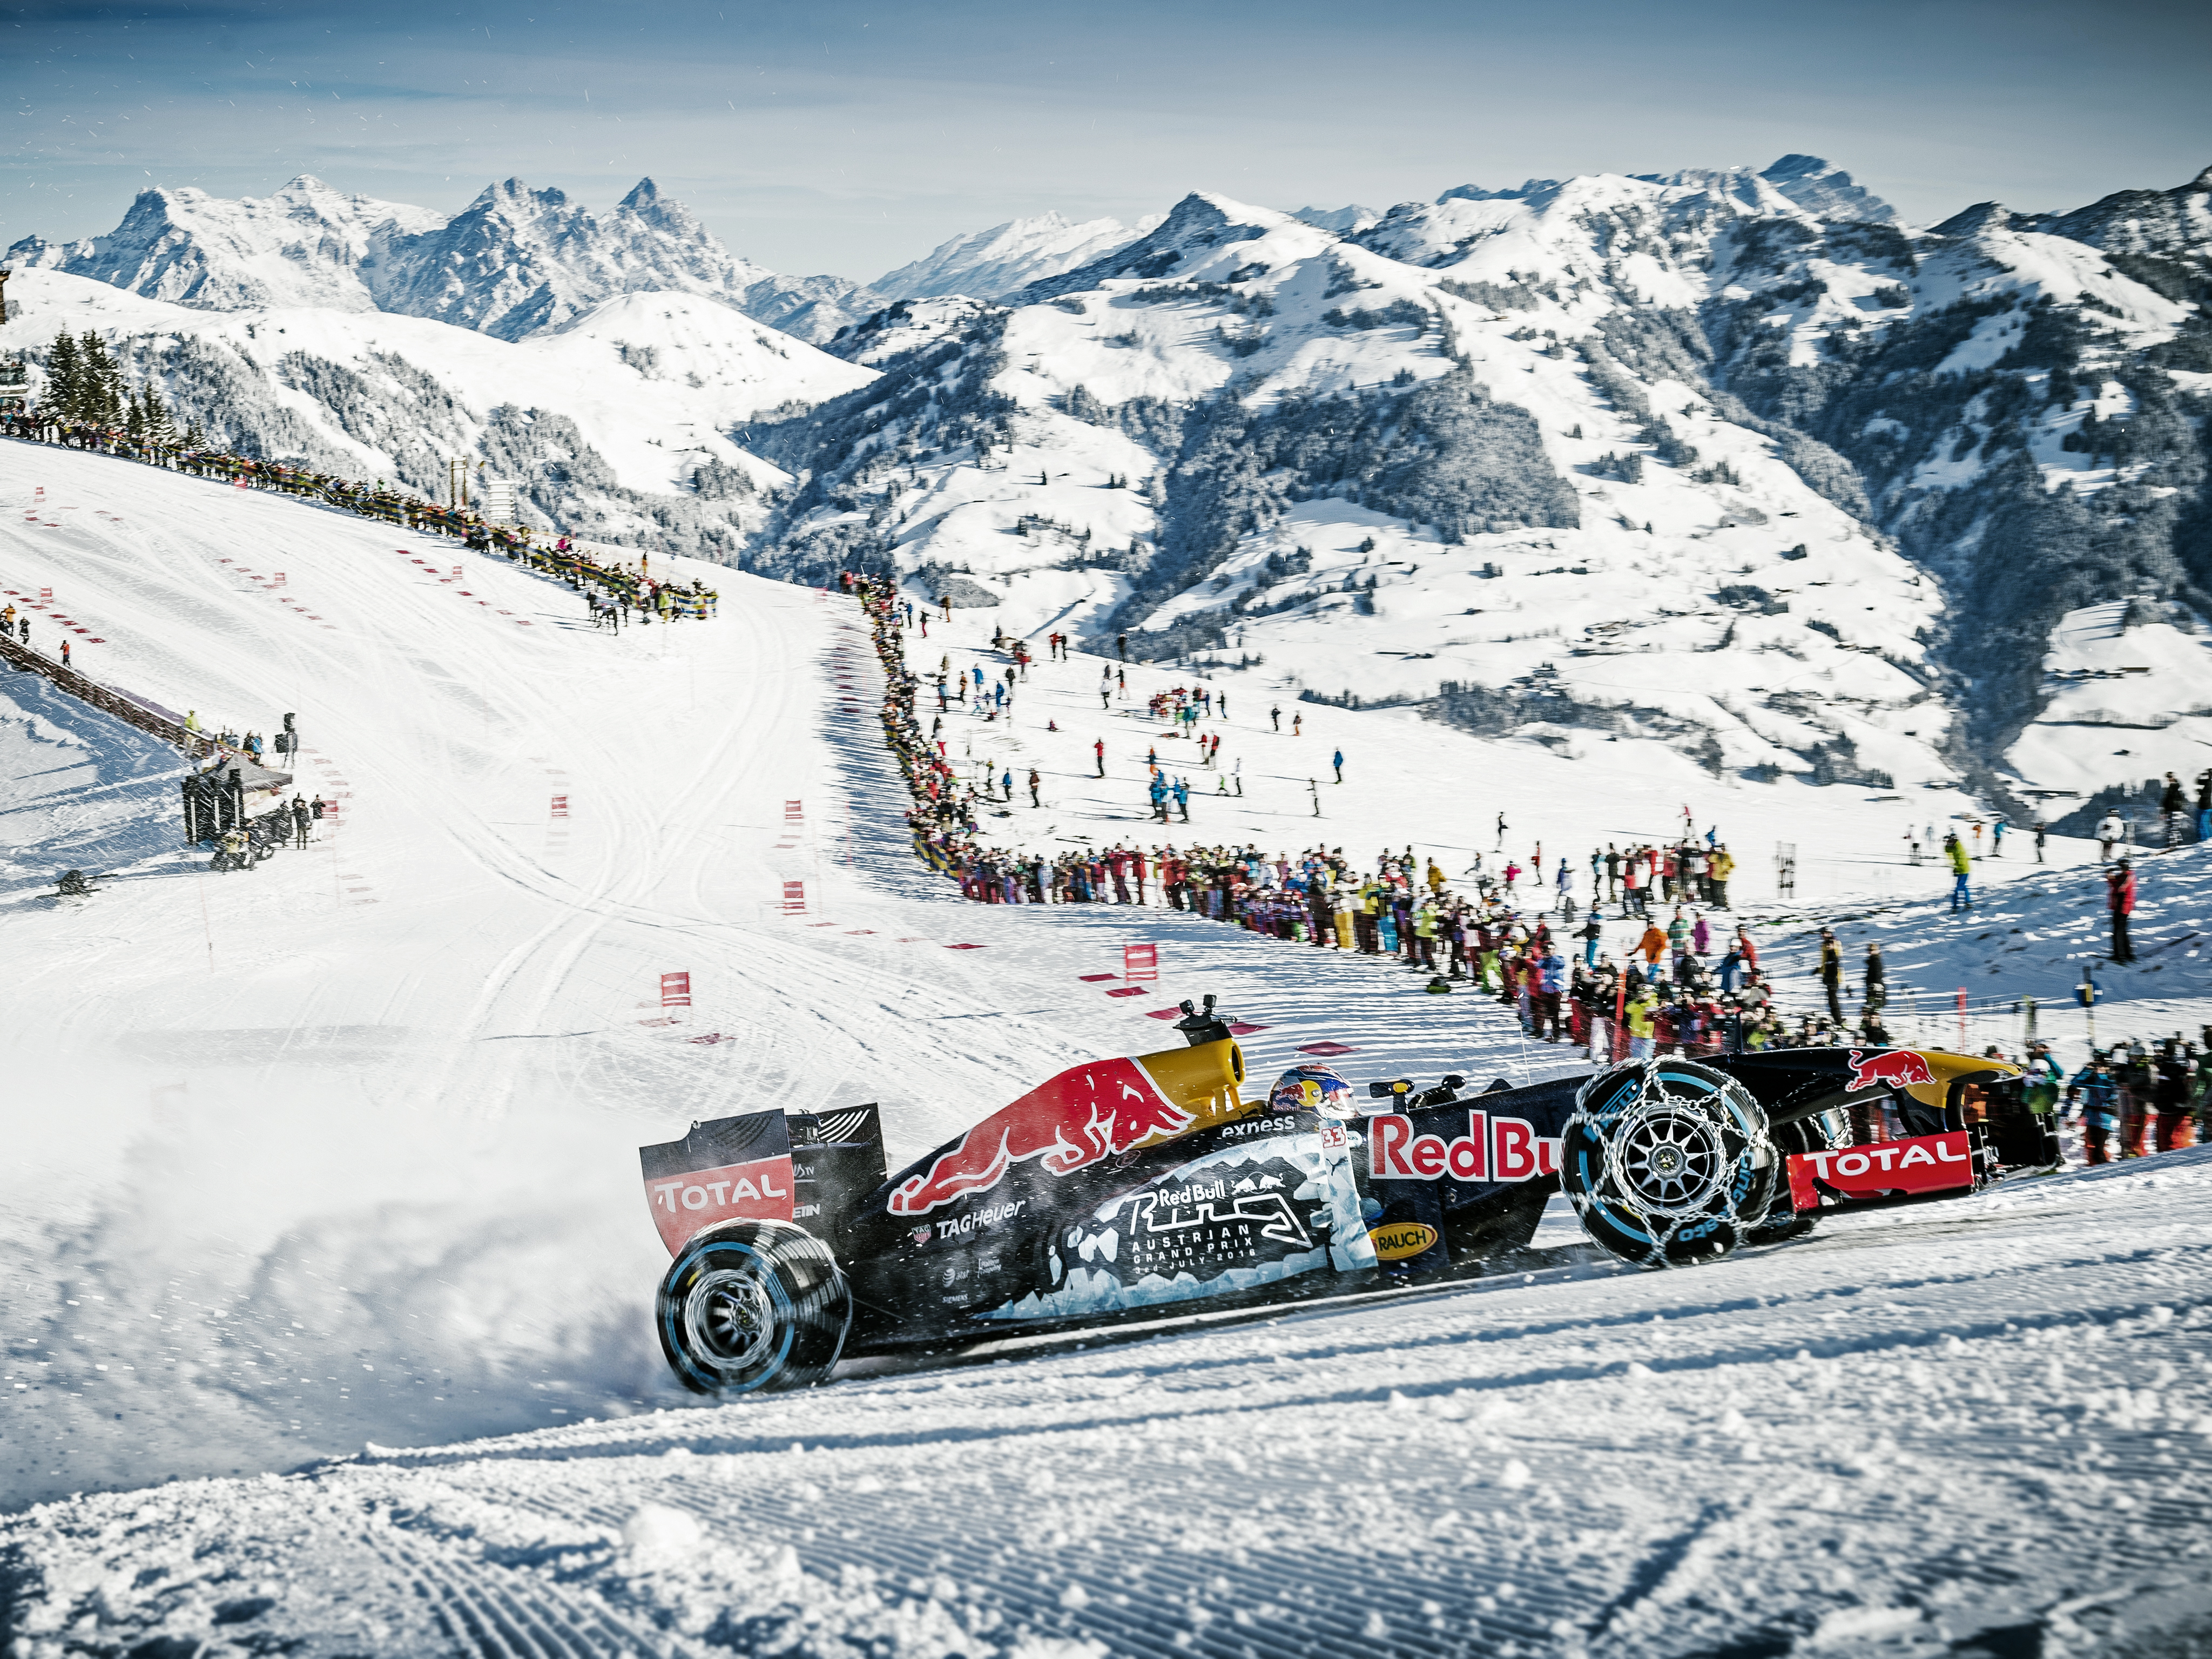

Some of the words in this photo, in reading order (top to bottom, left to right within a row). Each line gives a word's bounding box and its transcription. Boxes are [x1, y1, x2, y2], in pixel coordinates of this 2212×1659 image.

[1222, 1115, 1296, 1138] exness
[1321, 1126, 1346, 1149] 33
[1495, 1121, 1560, 1178] Bu
[1803, 1141, 1967, 1179] TOTAL
[654, 1174, 787, 1213] TOTAL
[1678, 1150, 1757, 1242] Cintato
[1132, 1224, 1249, 1253] AUSTRIAN
[1134, 1247, 1192, 1264] GRAND
[1208, 1237, 1252, 1253] PRIX
[1378, 1229, 1427, 1251] RAUCH
[1169, 1257, 1205, 1270] JULY
[1217, 1249, 1256, 1262] 2016
